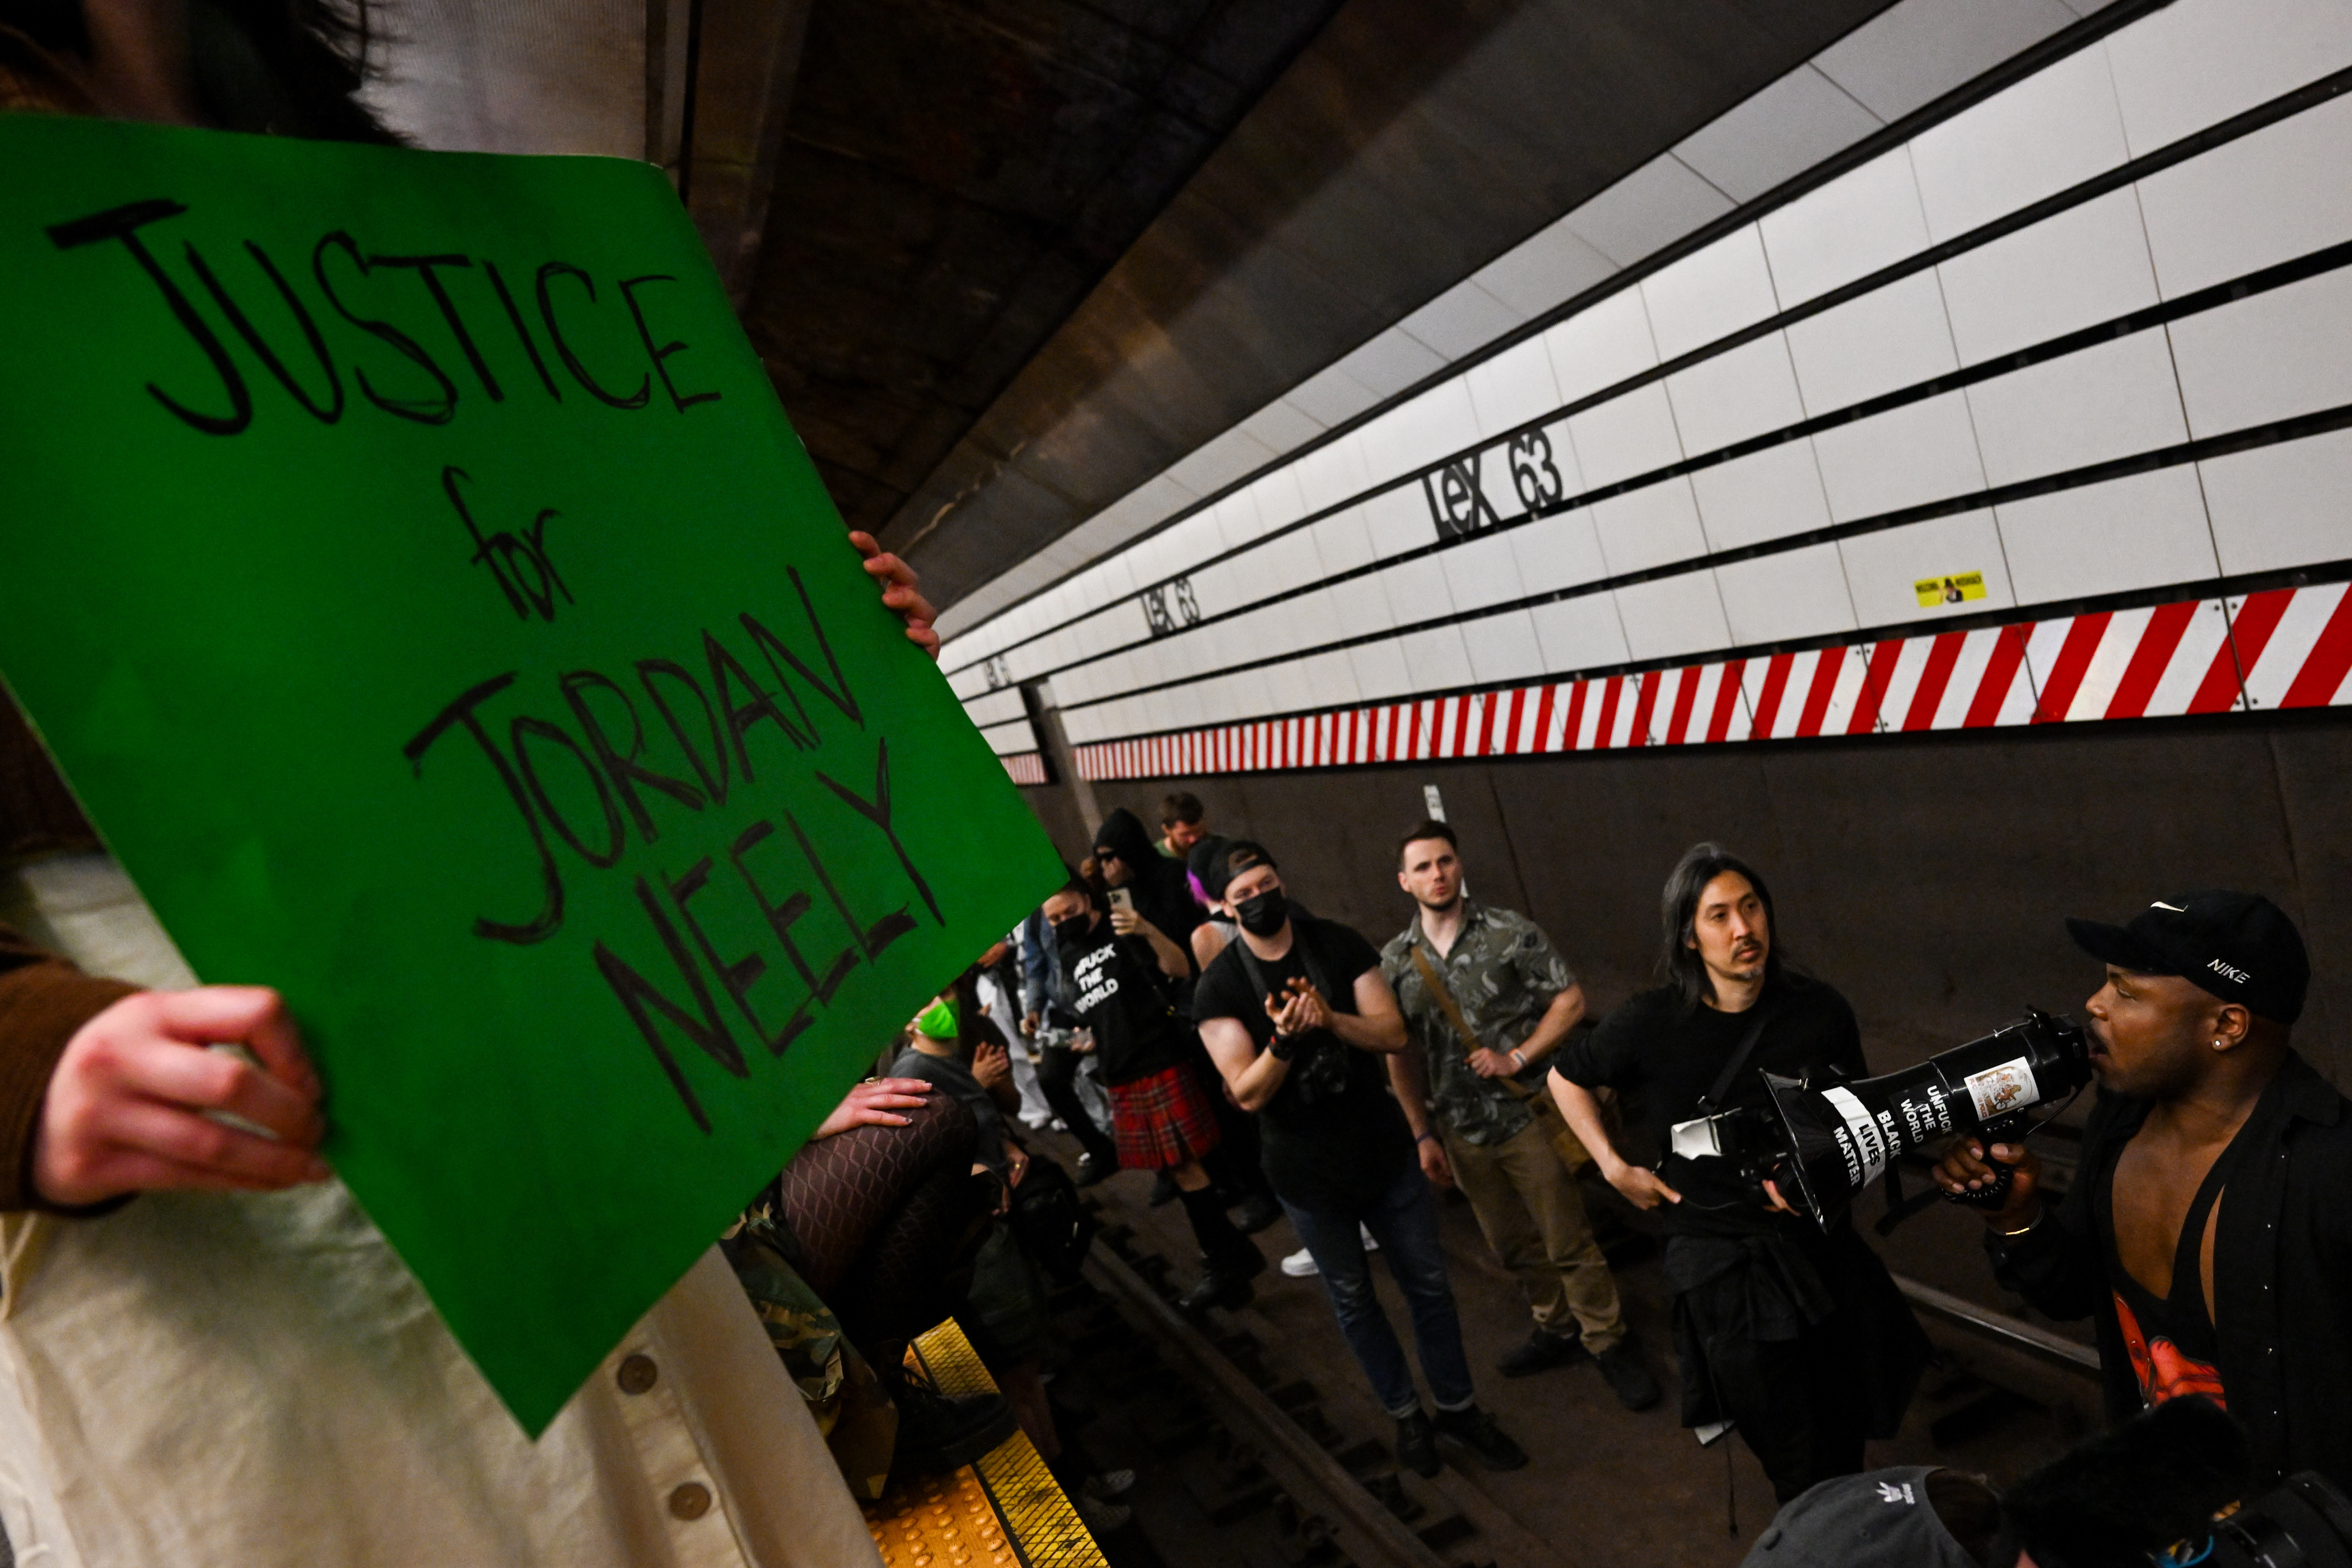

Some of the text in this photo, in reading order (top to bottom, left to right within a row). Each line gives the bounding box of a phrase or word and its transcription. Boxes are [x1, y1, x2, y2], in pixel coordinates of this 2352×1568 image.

[45, 198, 722, 436] JUSTICE
[1508, 428, 1563, 511] 63
[441, 465, 573, 623] for
[1174, 576, 1201, 626] 63
[404, 564, 865, 946] JORDAN
[593, 735, 946, 1137] NEELY
[1074, 978, 1119, 1014] WORLD
[2206, 958, 2251, 984] NIKE
[1877, 1109, 1901, 1160] BLACK
[1900, 1098, 1924, 1144] WORLD
[1919, 1103, 1936, 1131] THE
[1927, 1085, 1953, 1135] UNFUCK
[1833, 1126, 1860, 1187] MATTER
[1858, 1123, 1880, 1166] LIVES
